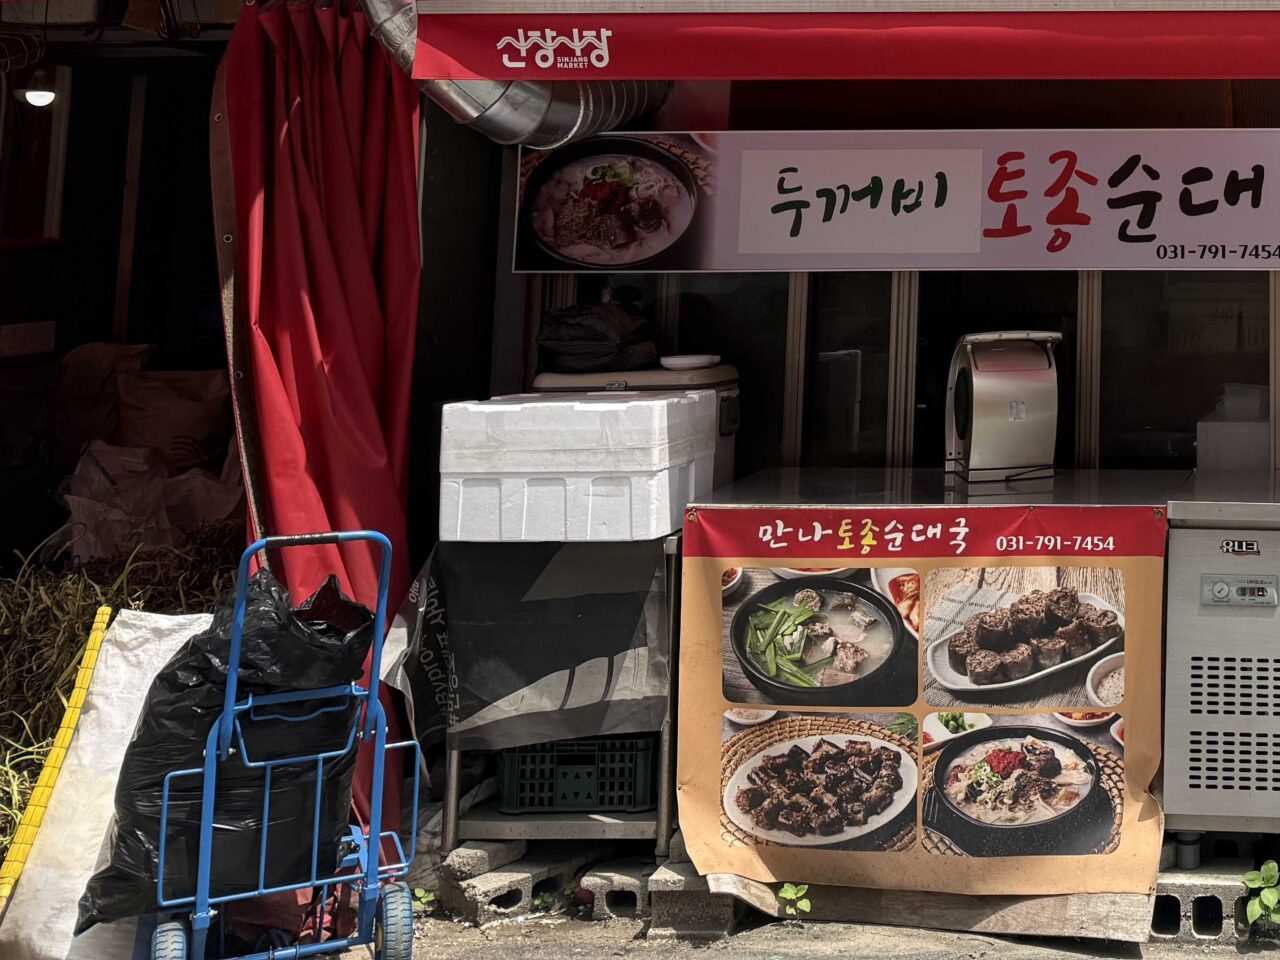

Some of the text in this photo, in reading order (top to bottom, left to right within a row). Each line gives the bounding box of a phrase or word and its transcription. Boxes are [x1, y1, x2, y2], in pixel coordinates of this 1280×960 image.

[770, 166, 949, 238] 두꺼비
[995, 535, 1116, 552] 031-791-7454
[1221, 539, 1260, 554] 유니크
